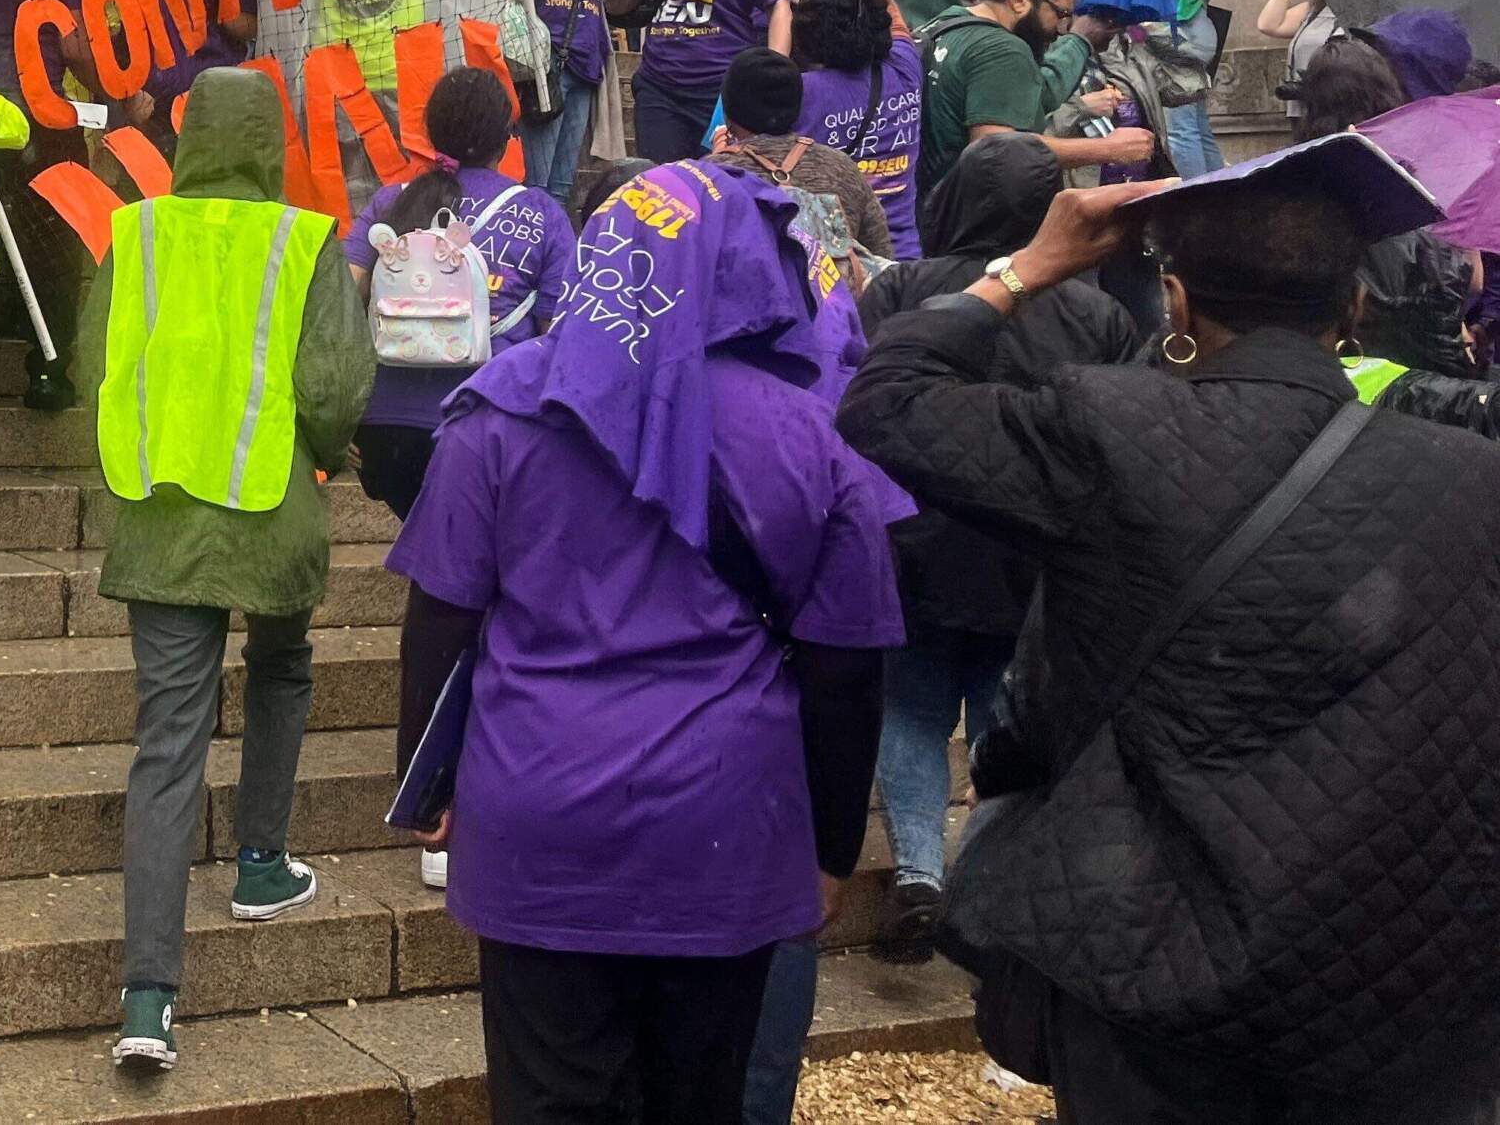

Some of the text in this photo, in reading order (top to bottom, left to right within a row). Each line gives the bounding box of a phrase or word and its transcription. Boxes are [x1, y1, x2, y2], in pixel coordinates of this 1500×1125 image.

[825, 88, 921, 129] QUALY CARE
[827, 131, 840, 145] &
[893, 107, 921, 126] JOB
[486, 218, 544, 244] JOBS
[477, 236, 533, 275] ALL
